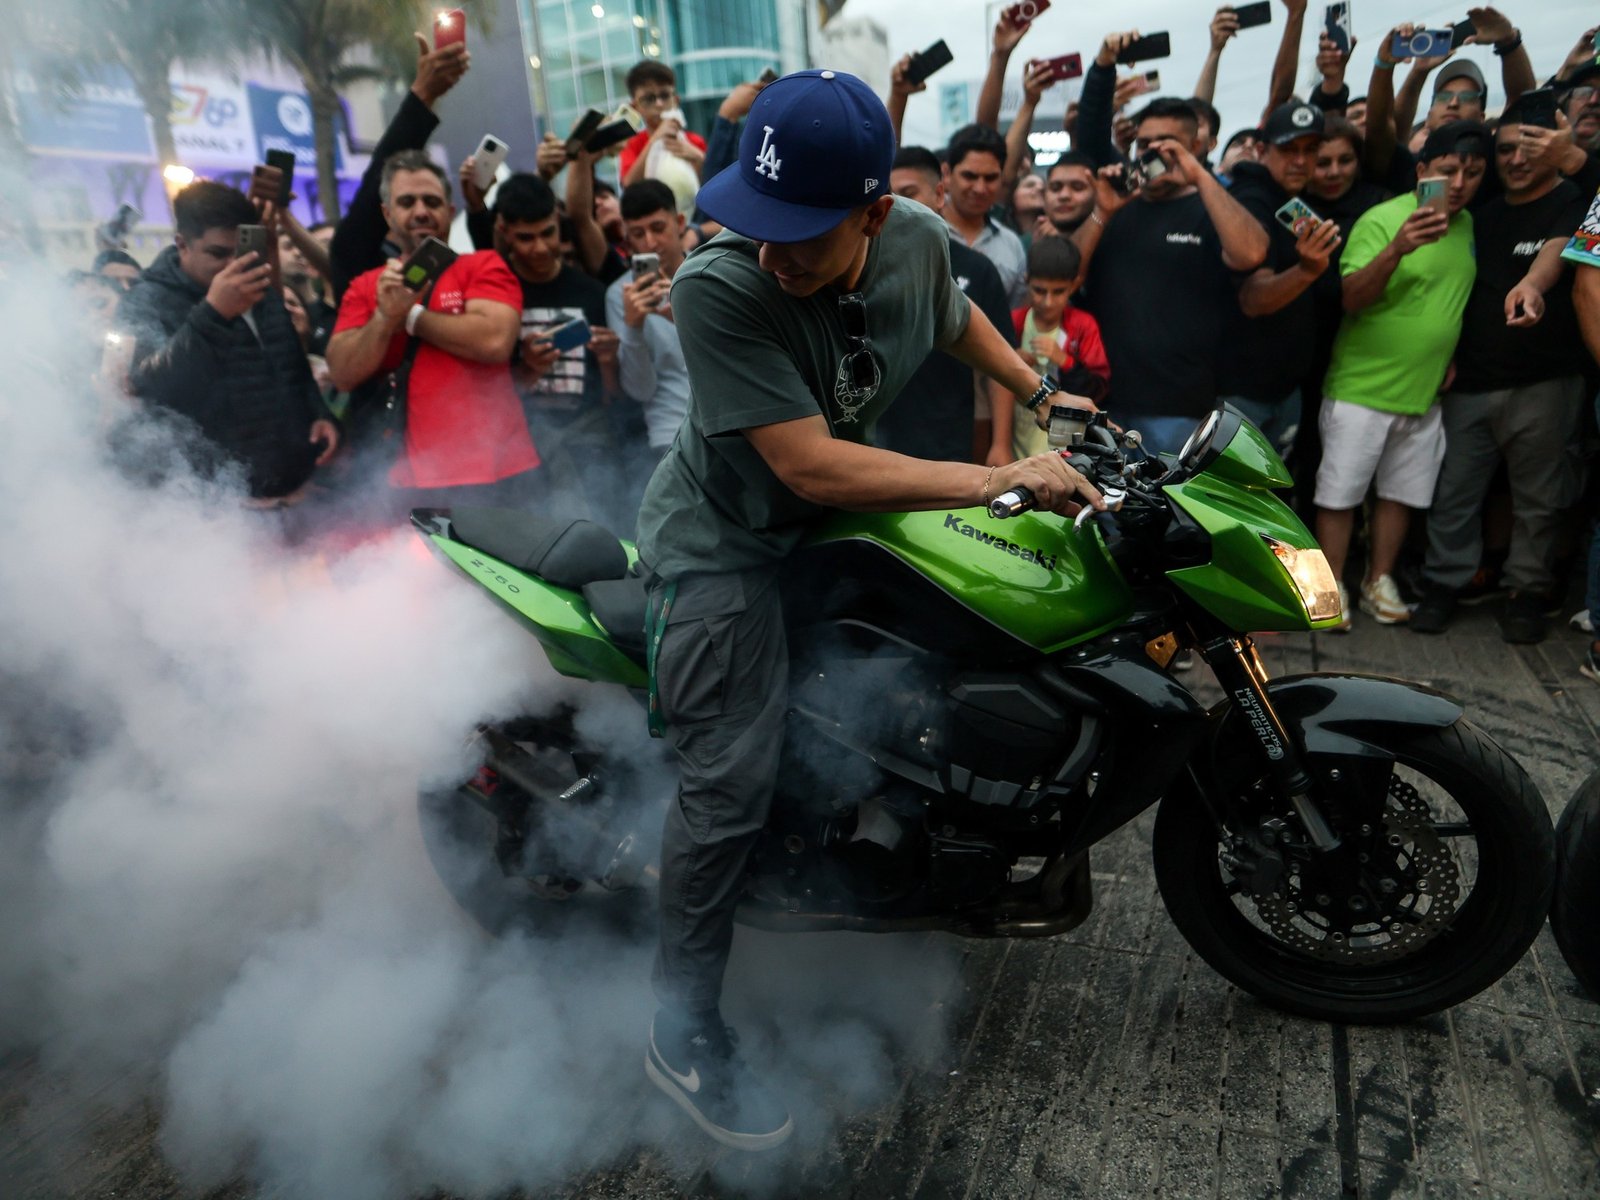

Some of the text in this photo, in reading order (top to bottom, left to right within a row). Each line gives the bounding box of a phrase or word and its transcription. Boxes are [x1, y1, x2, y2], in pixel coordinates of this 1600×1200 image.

[755, 125, 782, 181] LA
[943, 513, 1058, 571] Kawasaki
[1234, 689, 1251, 707] LA
[1244, 687, 1282, 748] NEUMATICOS
